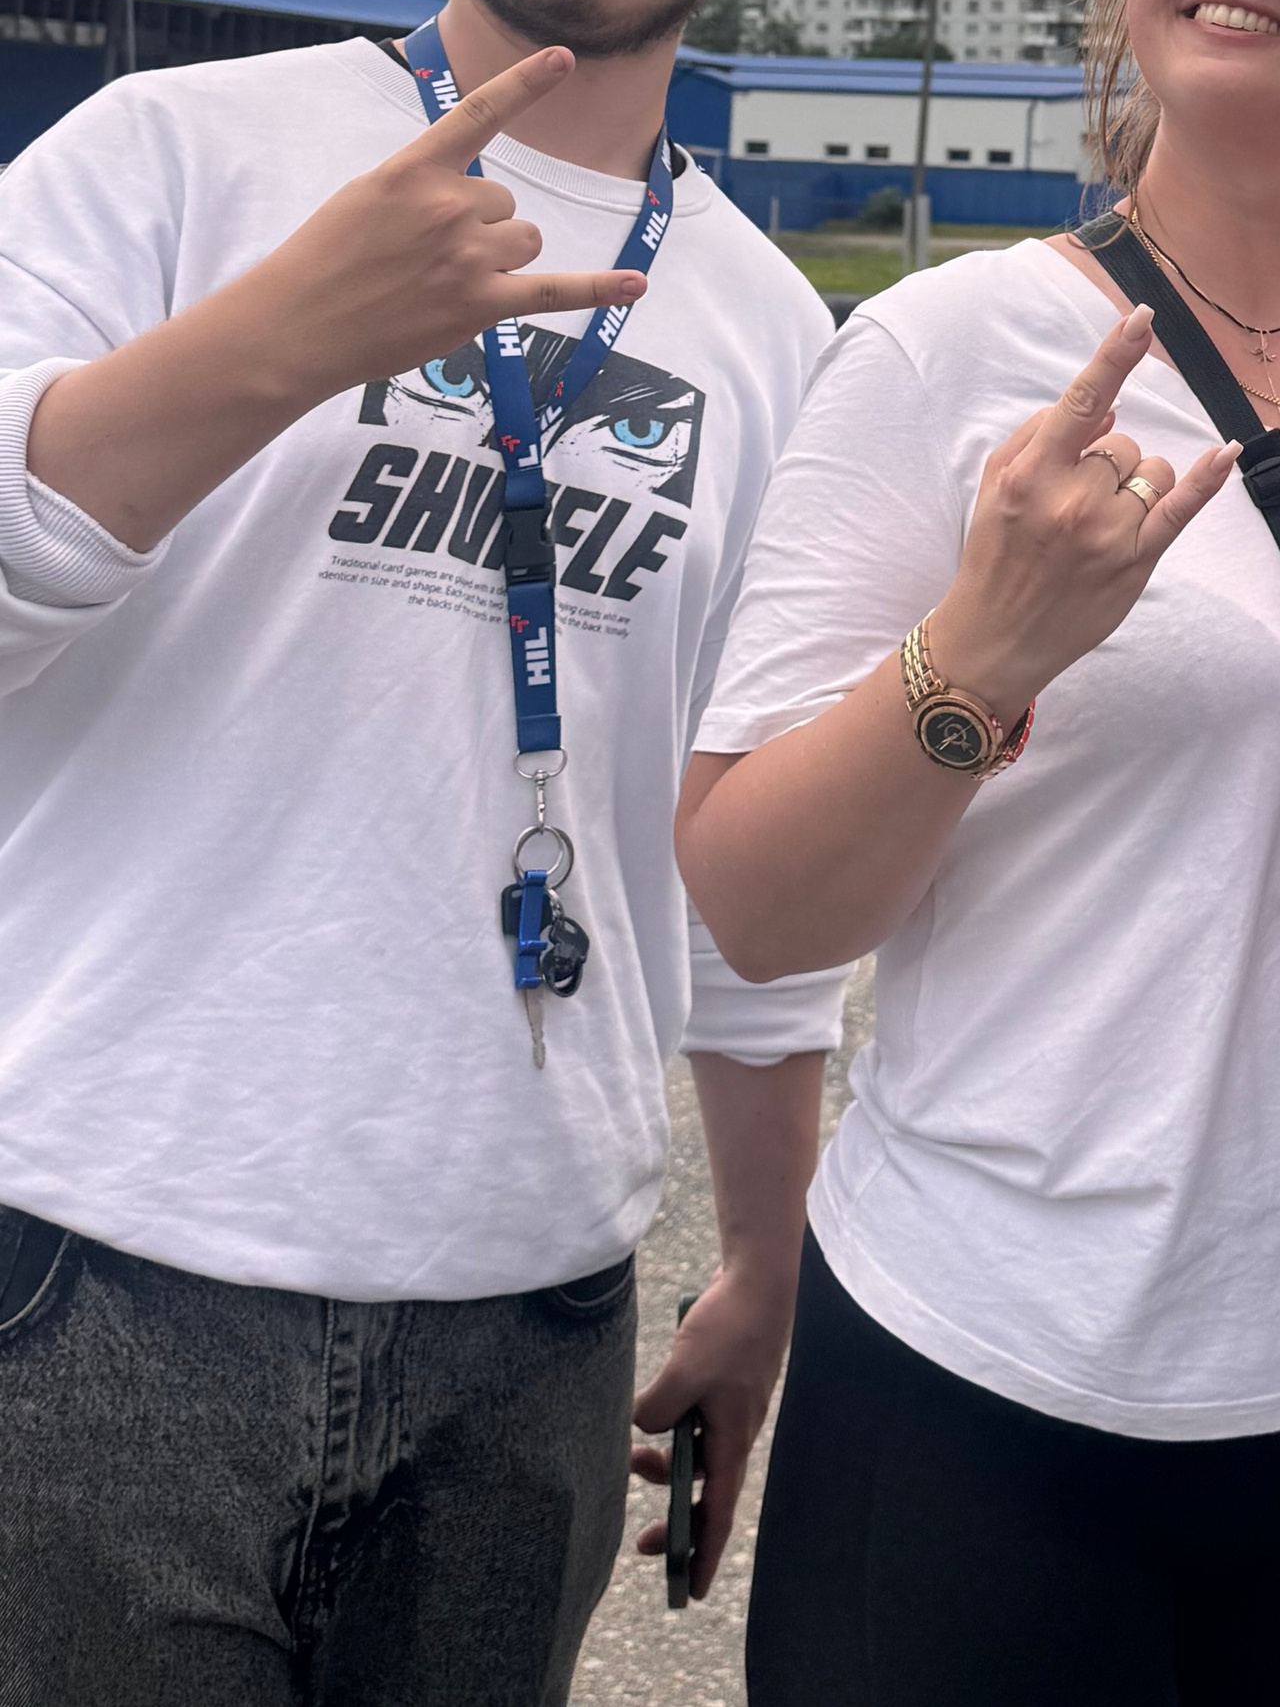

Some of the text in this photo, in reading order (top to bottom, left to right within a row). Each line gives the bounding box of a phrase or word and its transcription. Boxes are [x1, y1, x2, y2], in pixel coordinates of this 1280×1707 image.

[431, 70, 460, 110] HIL
[641, 211, 668, 250] HIL
[370, 576, 389, 586] size
[391, 579, 411, 589] and
[382, 563, 404, 574] card
[405, 567, 437, 578] games
[408, 594, 425, 605] the
[426, 597, 452, 610] backs
[525, 626, 551, 686] HIL
